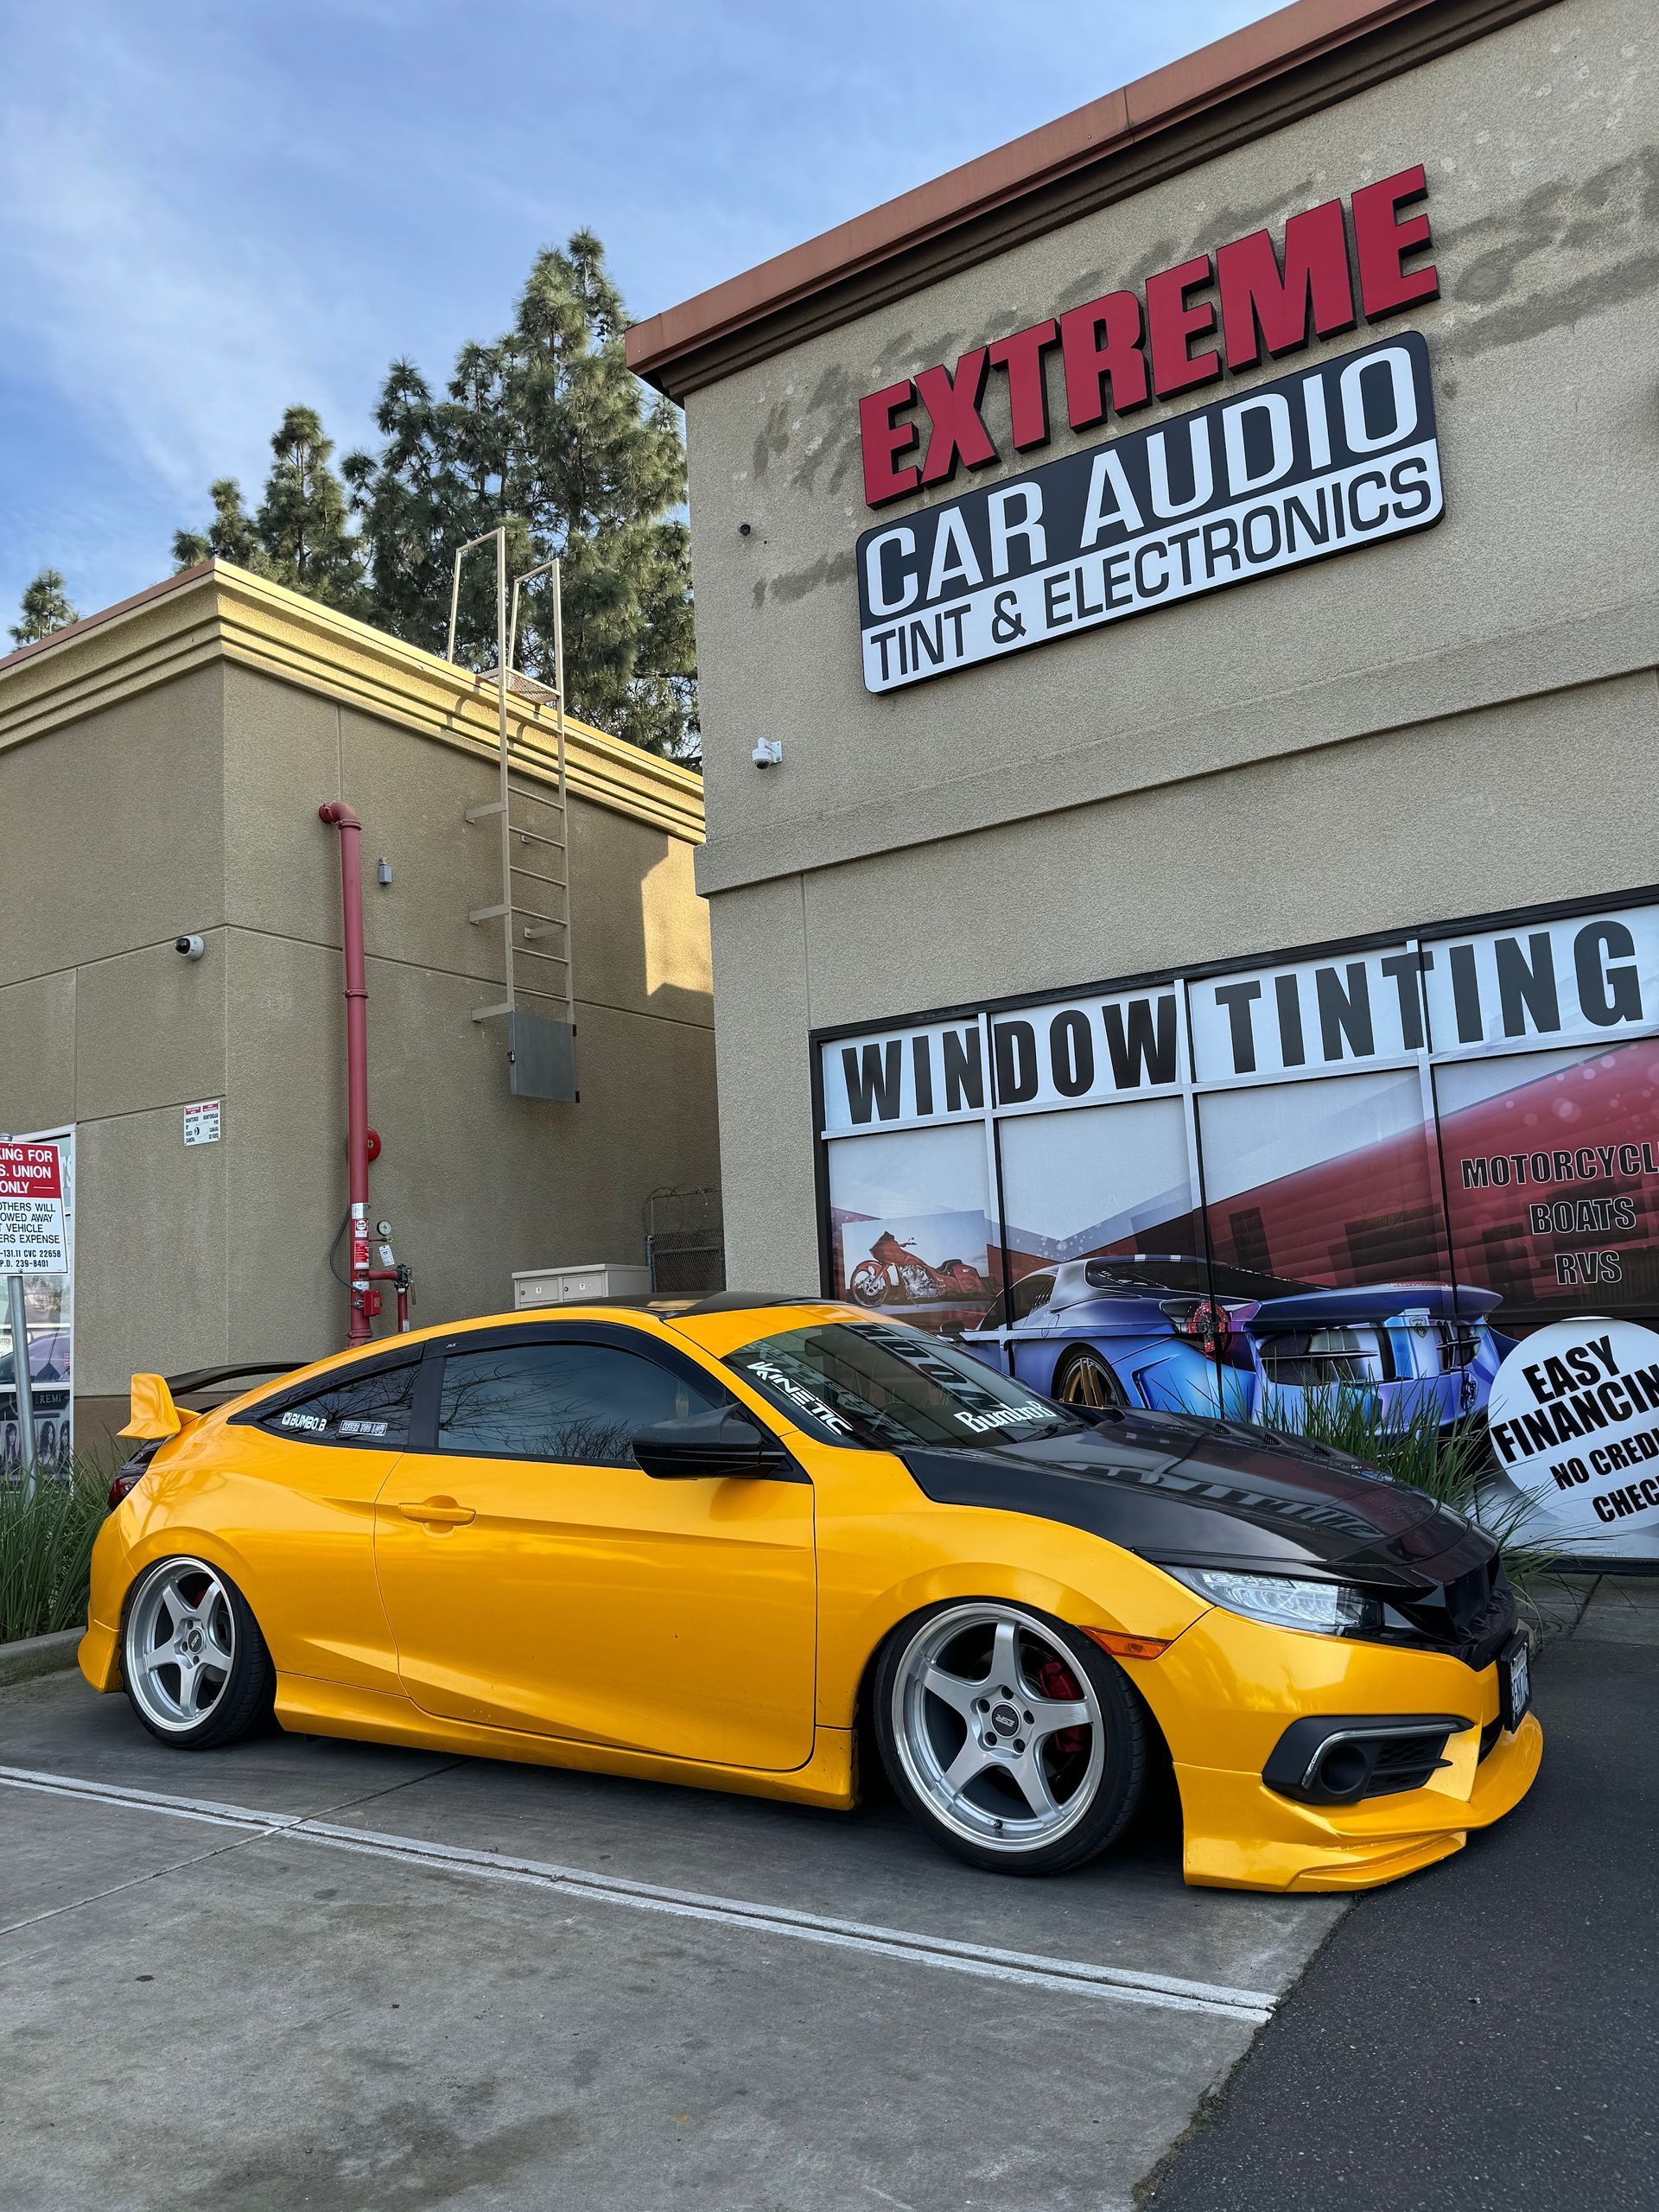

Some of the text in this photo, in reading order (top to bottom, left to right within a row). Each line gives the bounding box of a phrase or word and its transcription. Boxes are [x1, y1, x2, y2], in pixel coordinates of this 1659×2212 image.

[859, 164, 1440, 508] EXTREME
[865, 347, 1418, 617] CAR AUDIO
[870, 457, 1432, 681] TINT & ELECTRONICS
[841, 920, 1643, 1125] WINDOW TINTING
[12, 1164, 52, 1179] UNION
[28, 1149, 53, 1163] FOR
[1461, 1141, 1659, 1189] MOTORCYCL
[0, 1180, 29, 1194] ONLY
[31, 1213, 53, 1223] AWAY
[35, 1203, 56, 1212] WILL
[1529, 1197, 1637, 1235] BOATS
[6, 1224, 43, 1233] VEHICLE
[19, 1234, 60, 1244] EXPENSE
[16, 1259, 49, 1268] 239-8401
[23, 1249, 37, 1258] CVC
[39, 1249, 61, 1258] 22658
[1554, 1249, 1623, 1286] RVS
[1521, 1334, 1620, 1405] EASY
[1548, 1457, 1590, 1491] NO
[1592, 1474, 1659, 1523] CHEC
